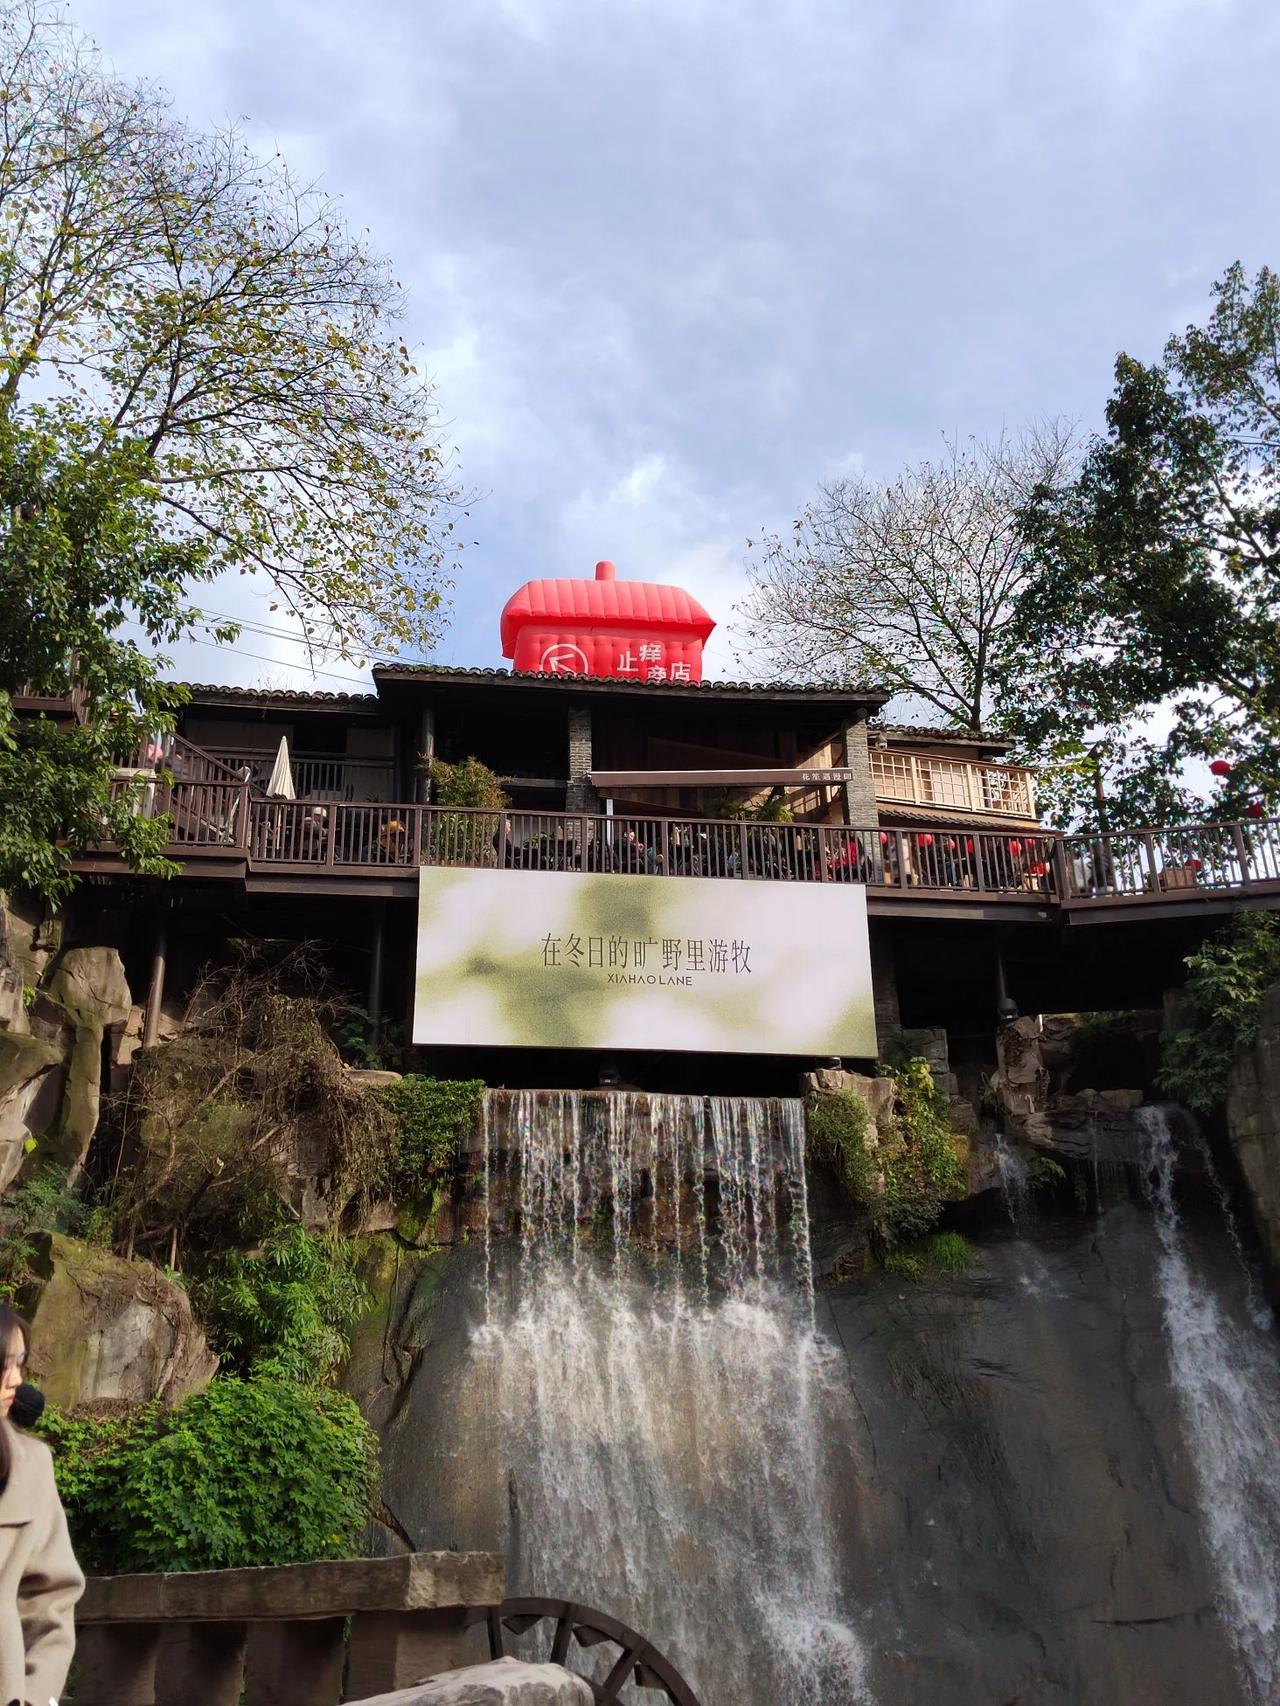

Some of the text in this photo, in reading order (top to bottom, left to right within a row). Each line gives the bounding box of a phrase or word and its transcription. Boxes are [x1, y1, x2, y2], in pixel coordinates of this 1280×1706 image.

[617, 643, 662, 672] 止痒
[541, 932, 752, 974] 在冬日的旷野里游牧
[607, 973, 693, 986] XIAHAO LANE
